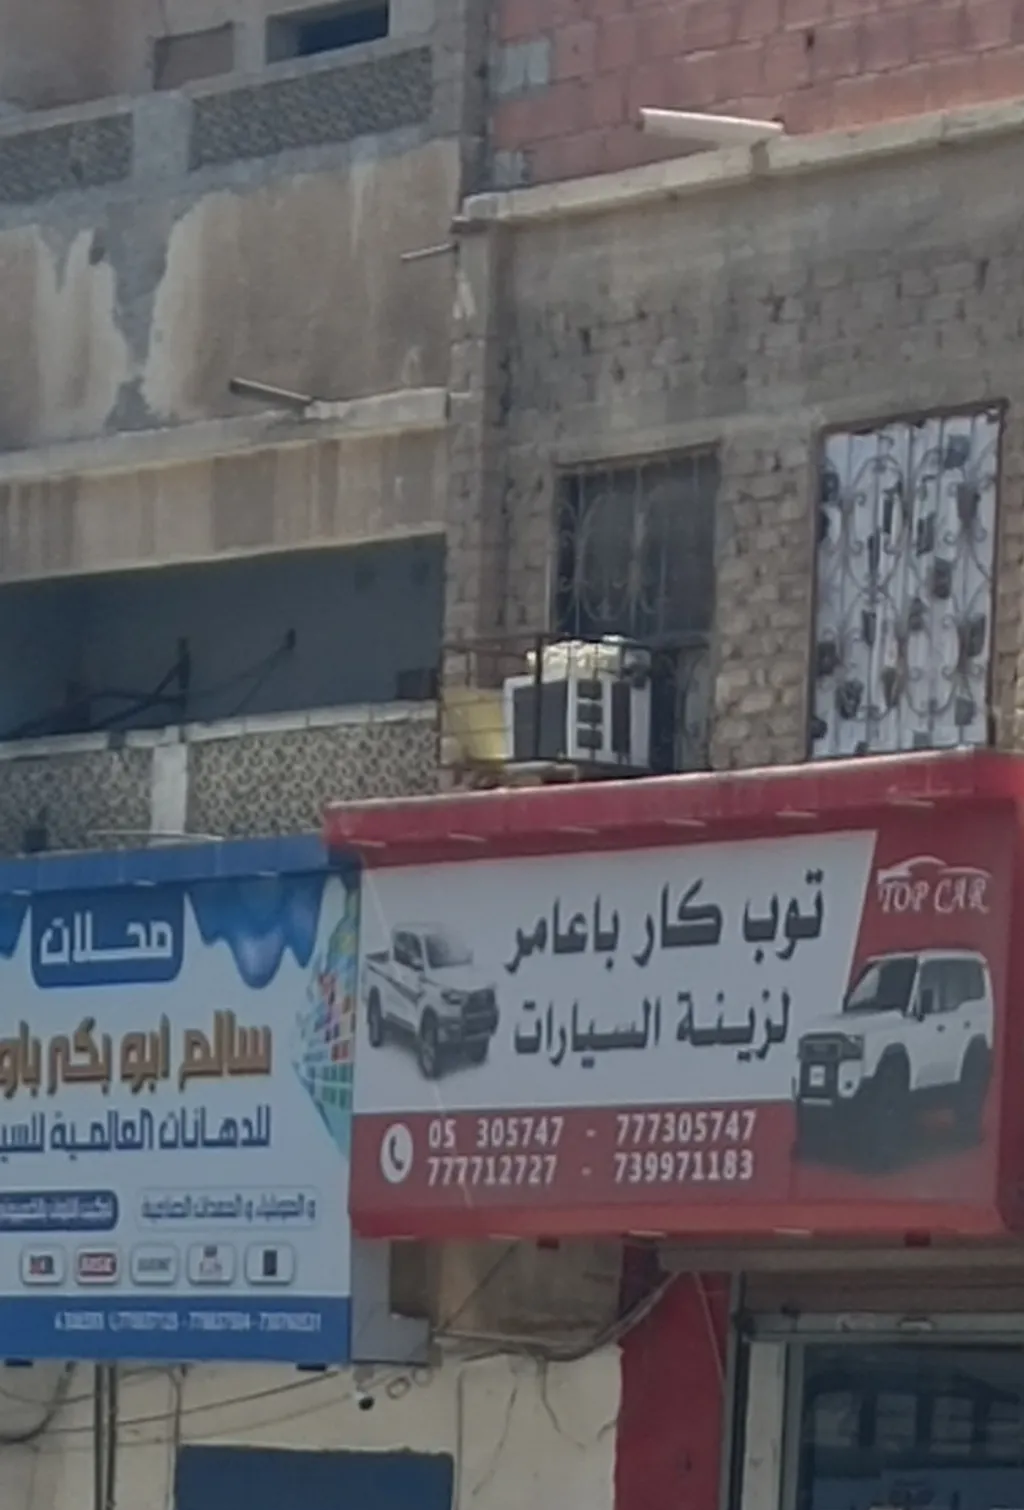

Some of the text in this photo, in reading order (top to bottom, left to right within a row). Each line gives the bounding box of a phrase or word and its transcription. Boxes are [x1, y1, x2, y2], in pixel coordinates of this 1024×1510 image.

[504, 870, 823, 971] توب كار باعامر
[878, 878, 992, 914] TOP CAR
[40, 910, 172, 964] محلات
[120, 1012, 170, 1094] ابو
[179, 1009, 272, 1089] سالم
[514, 990, 791, 1068] لزينة السيارات
[47, 1017, 112, 1097] بكر
[51, 1109, 153, 1161] العالمية
[159, 1105, 271, 1150] للدهانات
[428, 1119, 455, 1149] 05
[476, 1116, 564, 1147] 305747
[616, 1109, 757, 1145] 777305747
[427, 1156, 557, 1186] 777712727
[613, 1150, 753, 1183] 739971183
